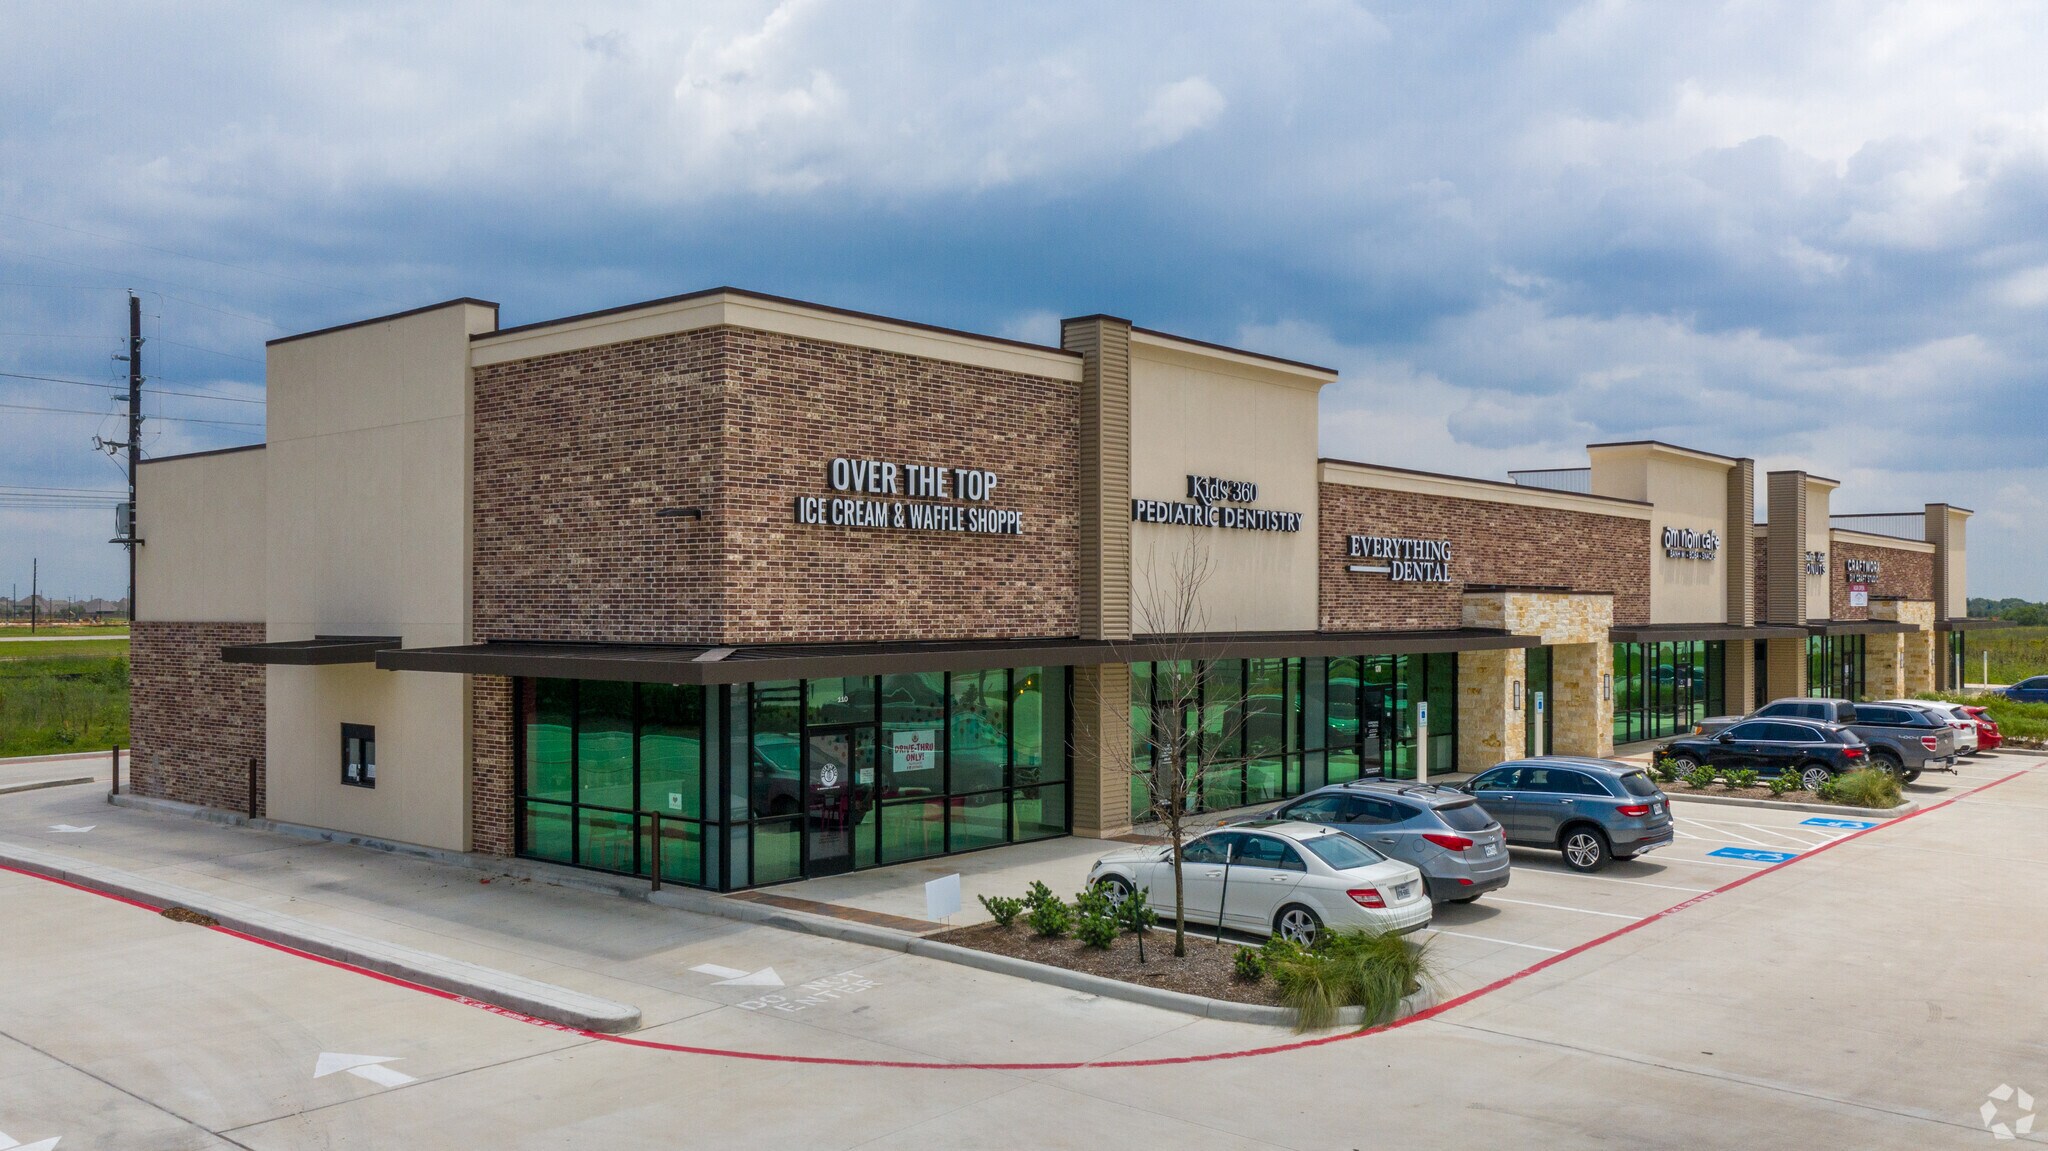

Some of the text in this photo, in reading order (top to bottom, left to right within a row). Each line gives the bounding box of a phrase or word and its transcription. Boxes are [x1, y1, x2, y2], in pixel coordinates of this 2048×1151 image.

[831, 457, 998, 501] OVER THE TOP
[1192, 475, 1259, 506] Kids 360
[799, 497, 1023, 535] ICE CREAM & WAFFLE SHOPPE
[1136, 500, 1304, 532] PEDIATRIC DENTISTRY
[1350, 535, 1452, 561] EVERYTHING
[1391, 560, 1452, 582] DENTAL
[837, 695, 849, 703] 110
[894, 743, 934, 753] DRIVE-THRU
[906, 752, 925, 762] ONLY!
[736, 970, 864, 1010] DO NOT
[773, 979, 883, 1012] ENTER
